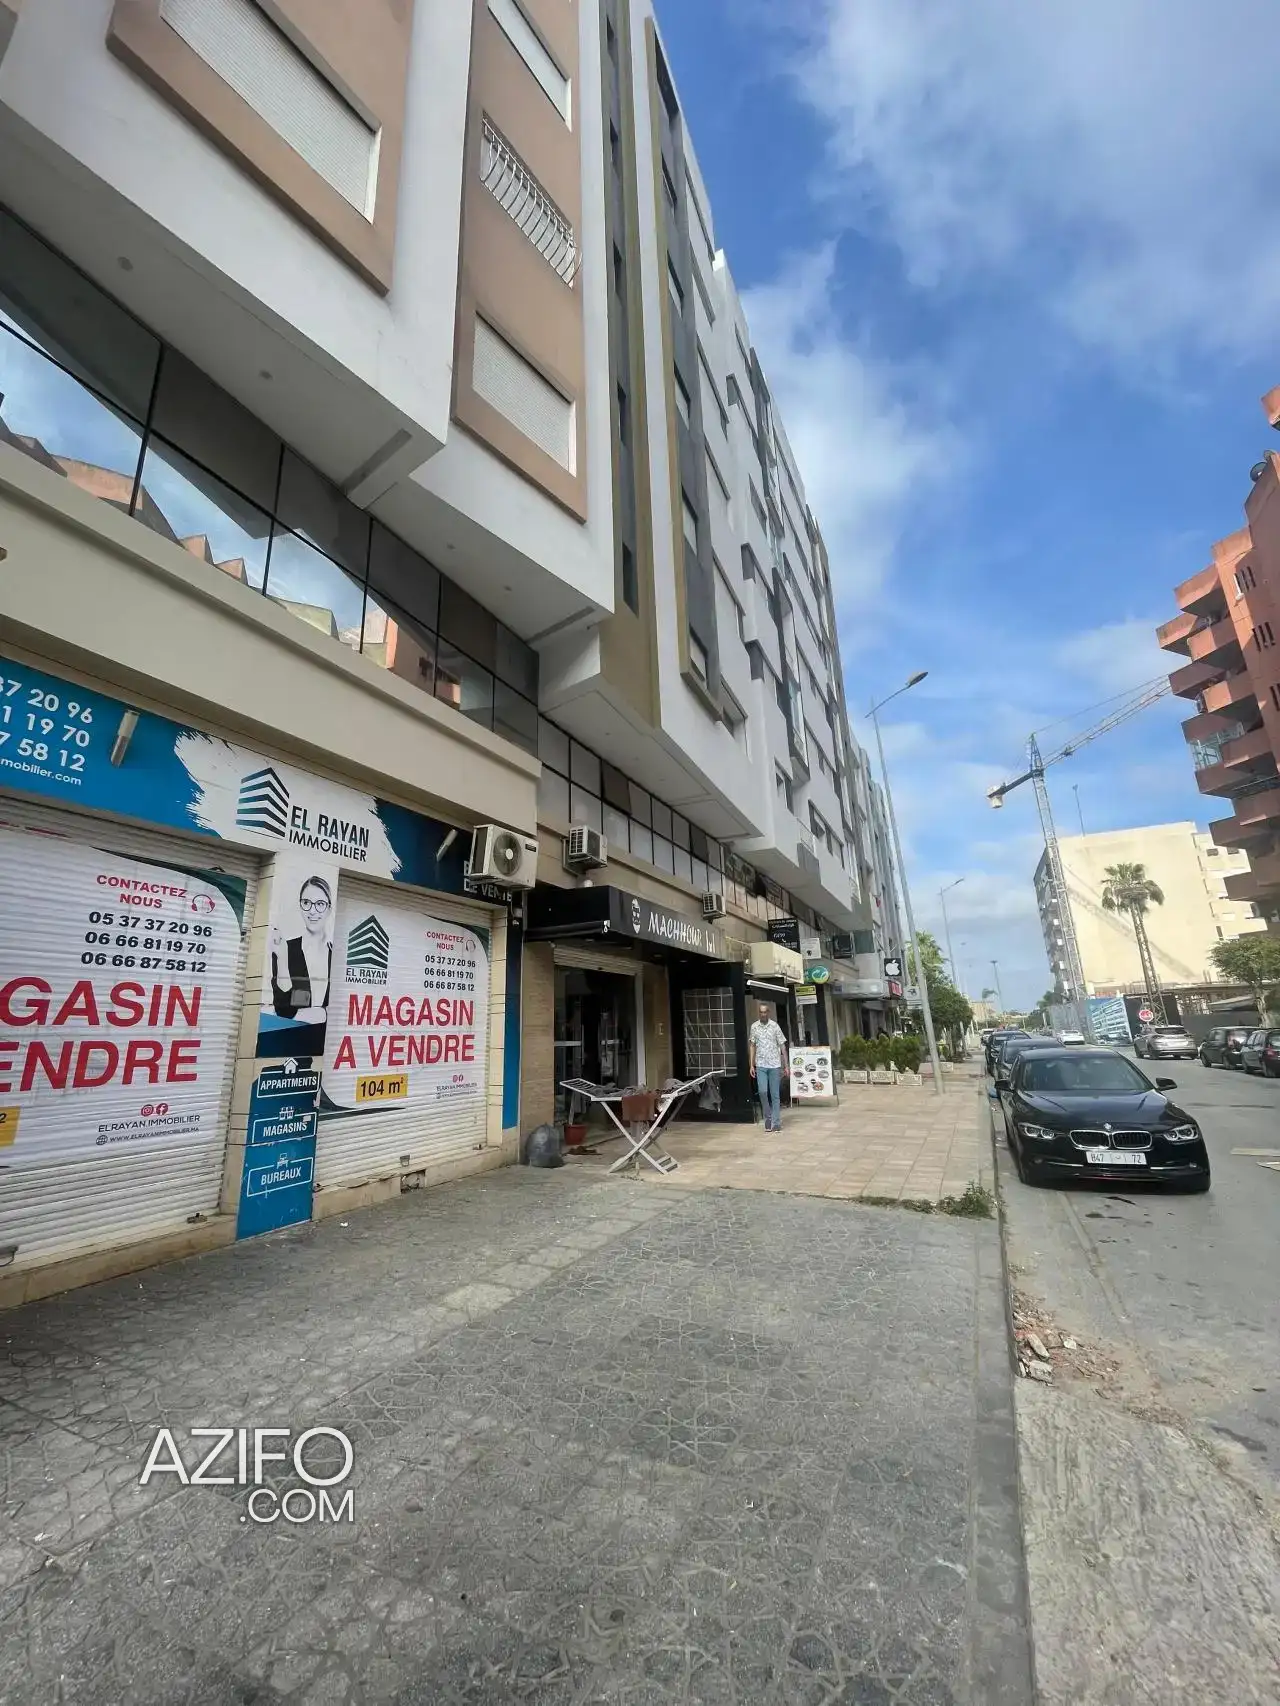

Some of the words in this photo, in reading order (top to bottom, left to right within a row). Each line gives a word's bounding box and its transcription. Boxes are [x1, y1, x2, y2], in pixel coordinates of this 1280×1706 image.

[28, 688, 60, 712] 20
[68, 702, 93, 724] 96
[26, 713, 54, 735] 19
[63, 724, 90, 747] 70
[17, 738, 48, 761] 58
[60, 749, 86, 772] 12
[290, 805, 311, 832] EL
[317, 813, 370, 848] RAYAN
[289, 829, 367, 862] IMMOBILIER
[97, 875, 188, 898] CONTACTEZ
[120, 893, 163, 909] NOUS
[89, 911, 114, 926] 05
[118, 915, 141, 928] 37
[144, 918, 166, 931] 37
[168, 922, 189, 935] 20
[193, 925, 213, 937] 96
[85, 931, 111, 945] 06
[115, 934, 139, 948] 66
[143, 937, 162, 950] 81
[166, 940, 183, 952] 19
[187, 942, 206, 954] 70
[426, 931, 464, 943] CONTACTEZ
[436, 942, 455, 951] NOUS
[81, 951, 107, 966] 06
[111, 954, 136, 968] 66
[139, 957, 163, 970] 87
[165, 959, 187, 972] 58
[190, 961, 207, 973] 12
[425, 954, 436, 963] 05
[436, 956, 446, 965] 37
[446, 957, 456, 966] 37
[456, 958, 466, 967] 20
[467, 960, 476, 968] 96
[345, 976, 387, 986] IMMOBILIER
[346, 968, 357, 977] EL
[359, 968, 388, 979] RAYAN
[424, 967, 435, 976] 06
[436, 968, 446, 977] 66
[447, 969, 456, 978] 81
[456, 970, 464, 979] 19
[465, 971, 474, 979] 70
[423, 980, 434, 989] 06
[435, 981, 446, 990] 66
[446, 982, 456, 990] 87
[456, 982, 466, 991] 58
[467, 983, 475, 991] 12
[0, 976, 202, 1027] GASIN
[347, 994, 474, 1027] MAGASIN
[333, 1035, 357, 1070] A
[367, 1034, 476, 1068] VENDRE
[260, 1076, 317, 1090] APPARTMENTS
[360, 1079, 385, 1097] 104
[98, 1114, 201, 1133] ELRAYAN.IMMOBILIER
[262, 1121, 307, 1137] MAGASINS
[260, 1166, 302, 1186] BUREAUX
